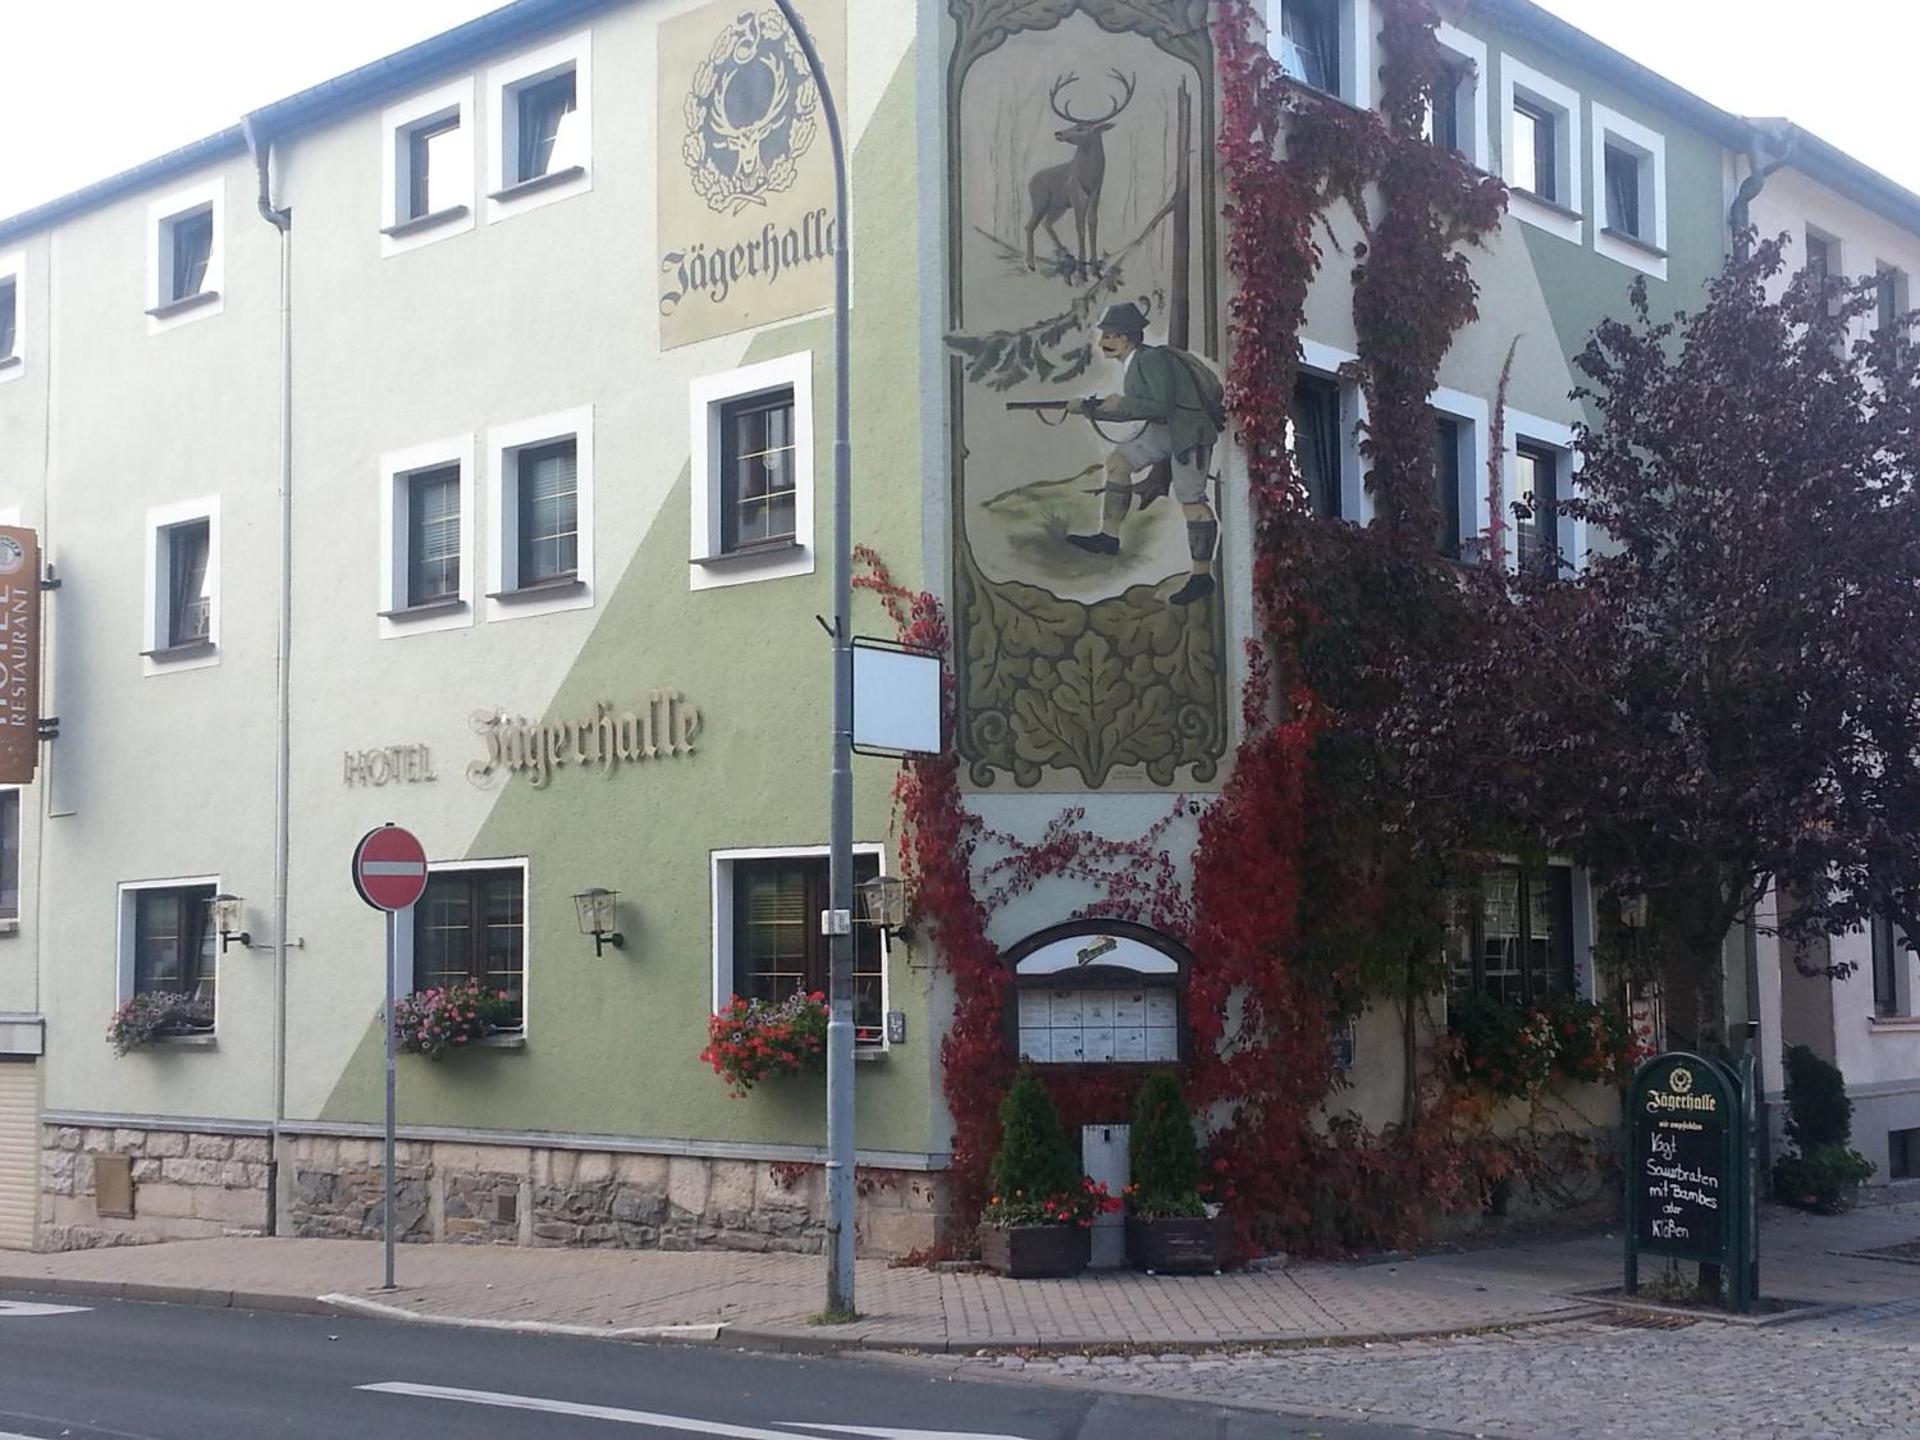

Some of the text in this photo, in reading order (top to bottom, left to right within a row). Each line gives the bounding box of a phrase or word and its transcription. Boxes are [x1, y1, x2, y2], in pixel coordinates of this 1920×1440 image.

[11, 590, 28, 727] RESTAURANT
[344, 687, 703, 789] HOTEL Jägerhalle
[1649, 1180, 1669, 1197] mit
[1662, 1201, 1683, 1215] oder
